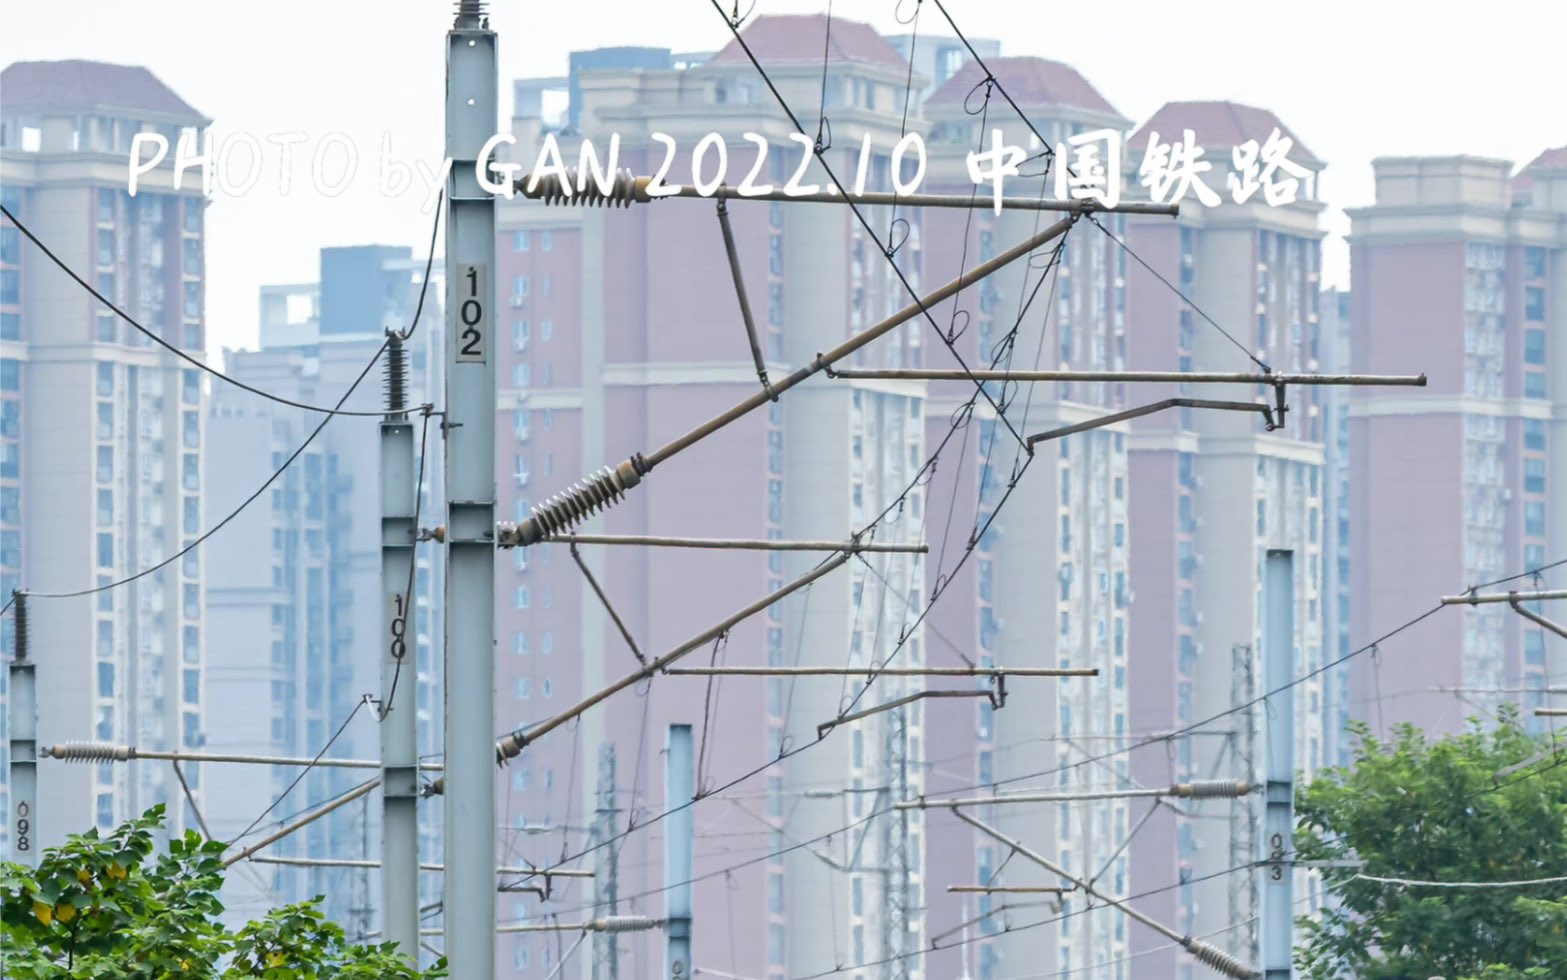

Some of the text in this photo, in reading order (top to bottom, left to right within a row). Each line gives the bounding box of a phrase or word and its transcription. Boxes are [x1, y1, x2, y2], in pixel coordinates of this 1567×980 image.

[461, 266, 482, 355] 102
[391, 594, 406, 659] 100
[17, 801, 30, 851] 098
